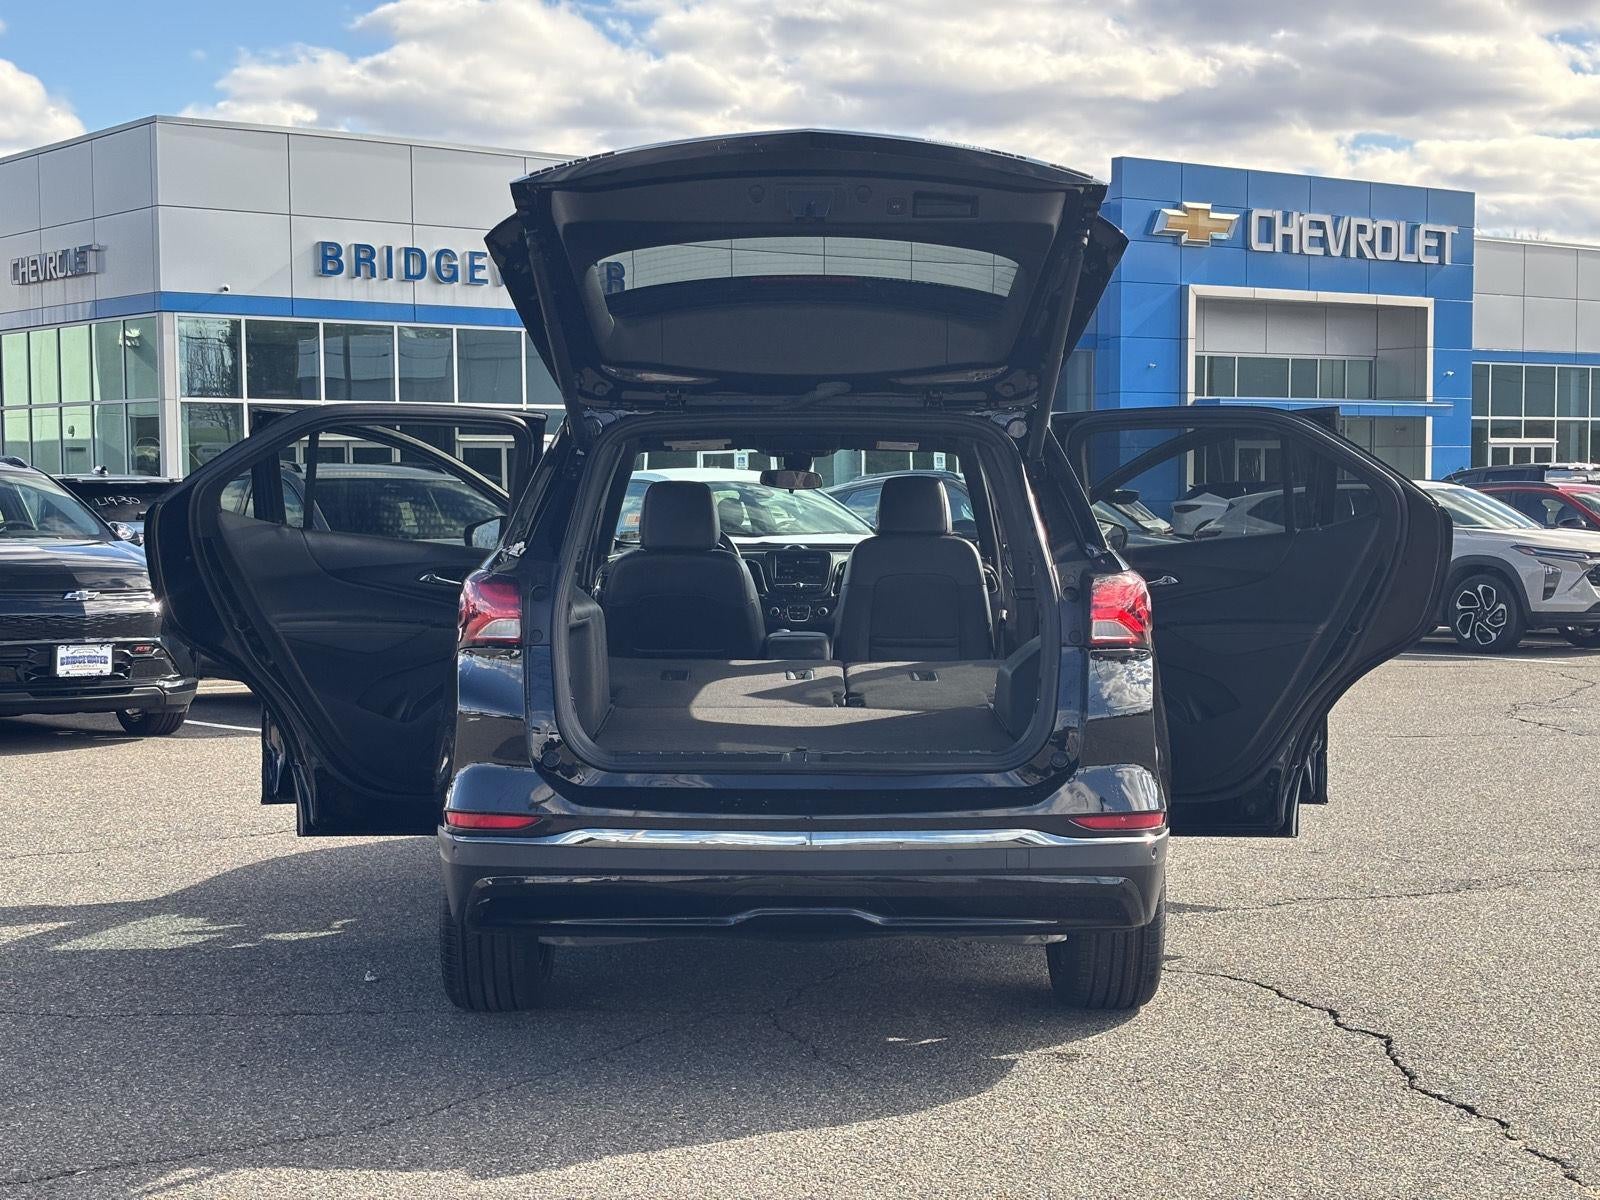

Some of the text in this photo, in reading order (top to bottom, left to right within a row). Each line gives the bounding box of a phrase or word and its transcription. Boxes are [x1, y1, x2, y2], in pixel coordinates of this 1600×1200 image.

[1251, 208, 1459, 265] CHEVROLET
[10, 245, 99, 286] CHEVROLET
[60, 655, 109, 666] BRIDGEWATER
